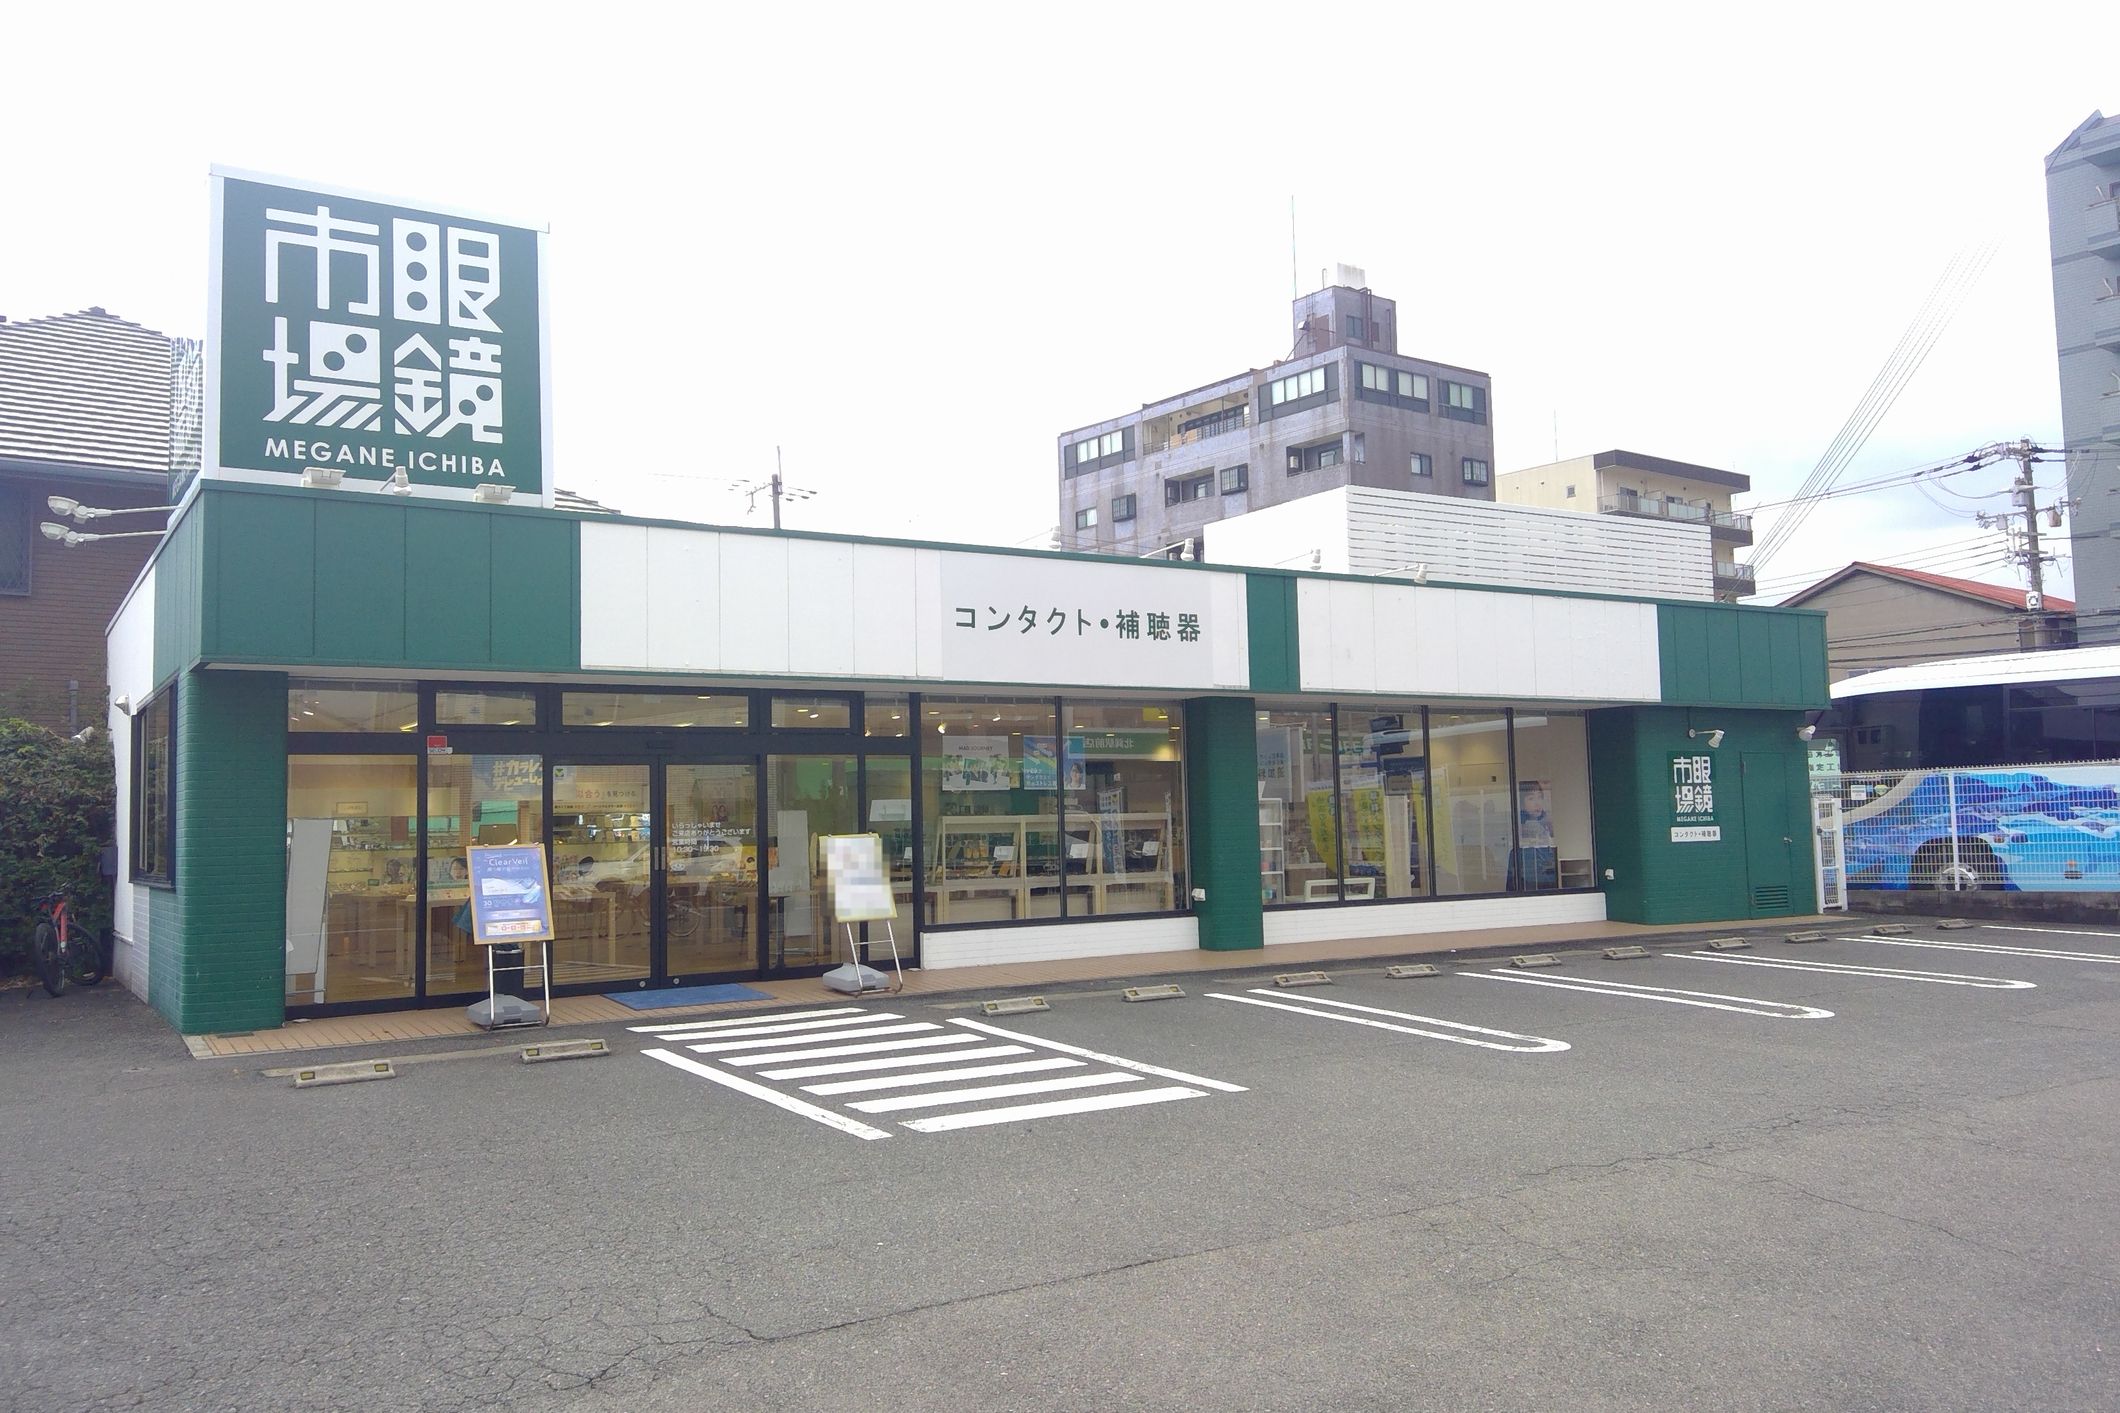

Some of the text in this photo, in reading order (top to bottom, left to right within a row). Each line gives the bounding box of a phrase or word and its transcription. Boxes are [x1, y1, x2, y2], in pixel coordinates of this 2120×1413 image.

[264, 437, 505, 477] MEGANE ICHIBA
[955, 604, 1201, 642] コンタクト・補聴器
